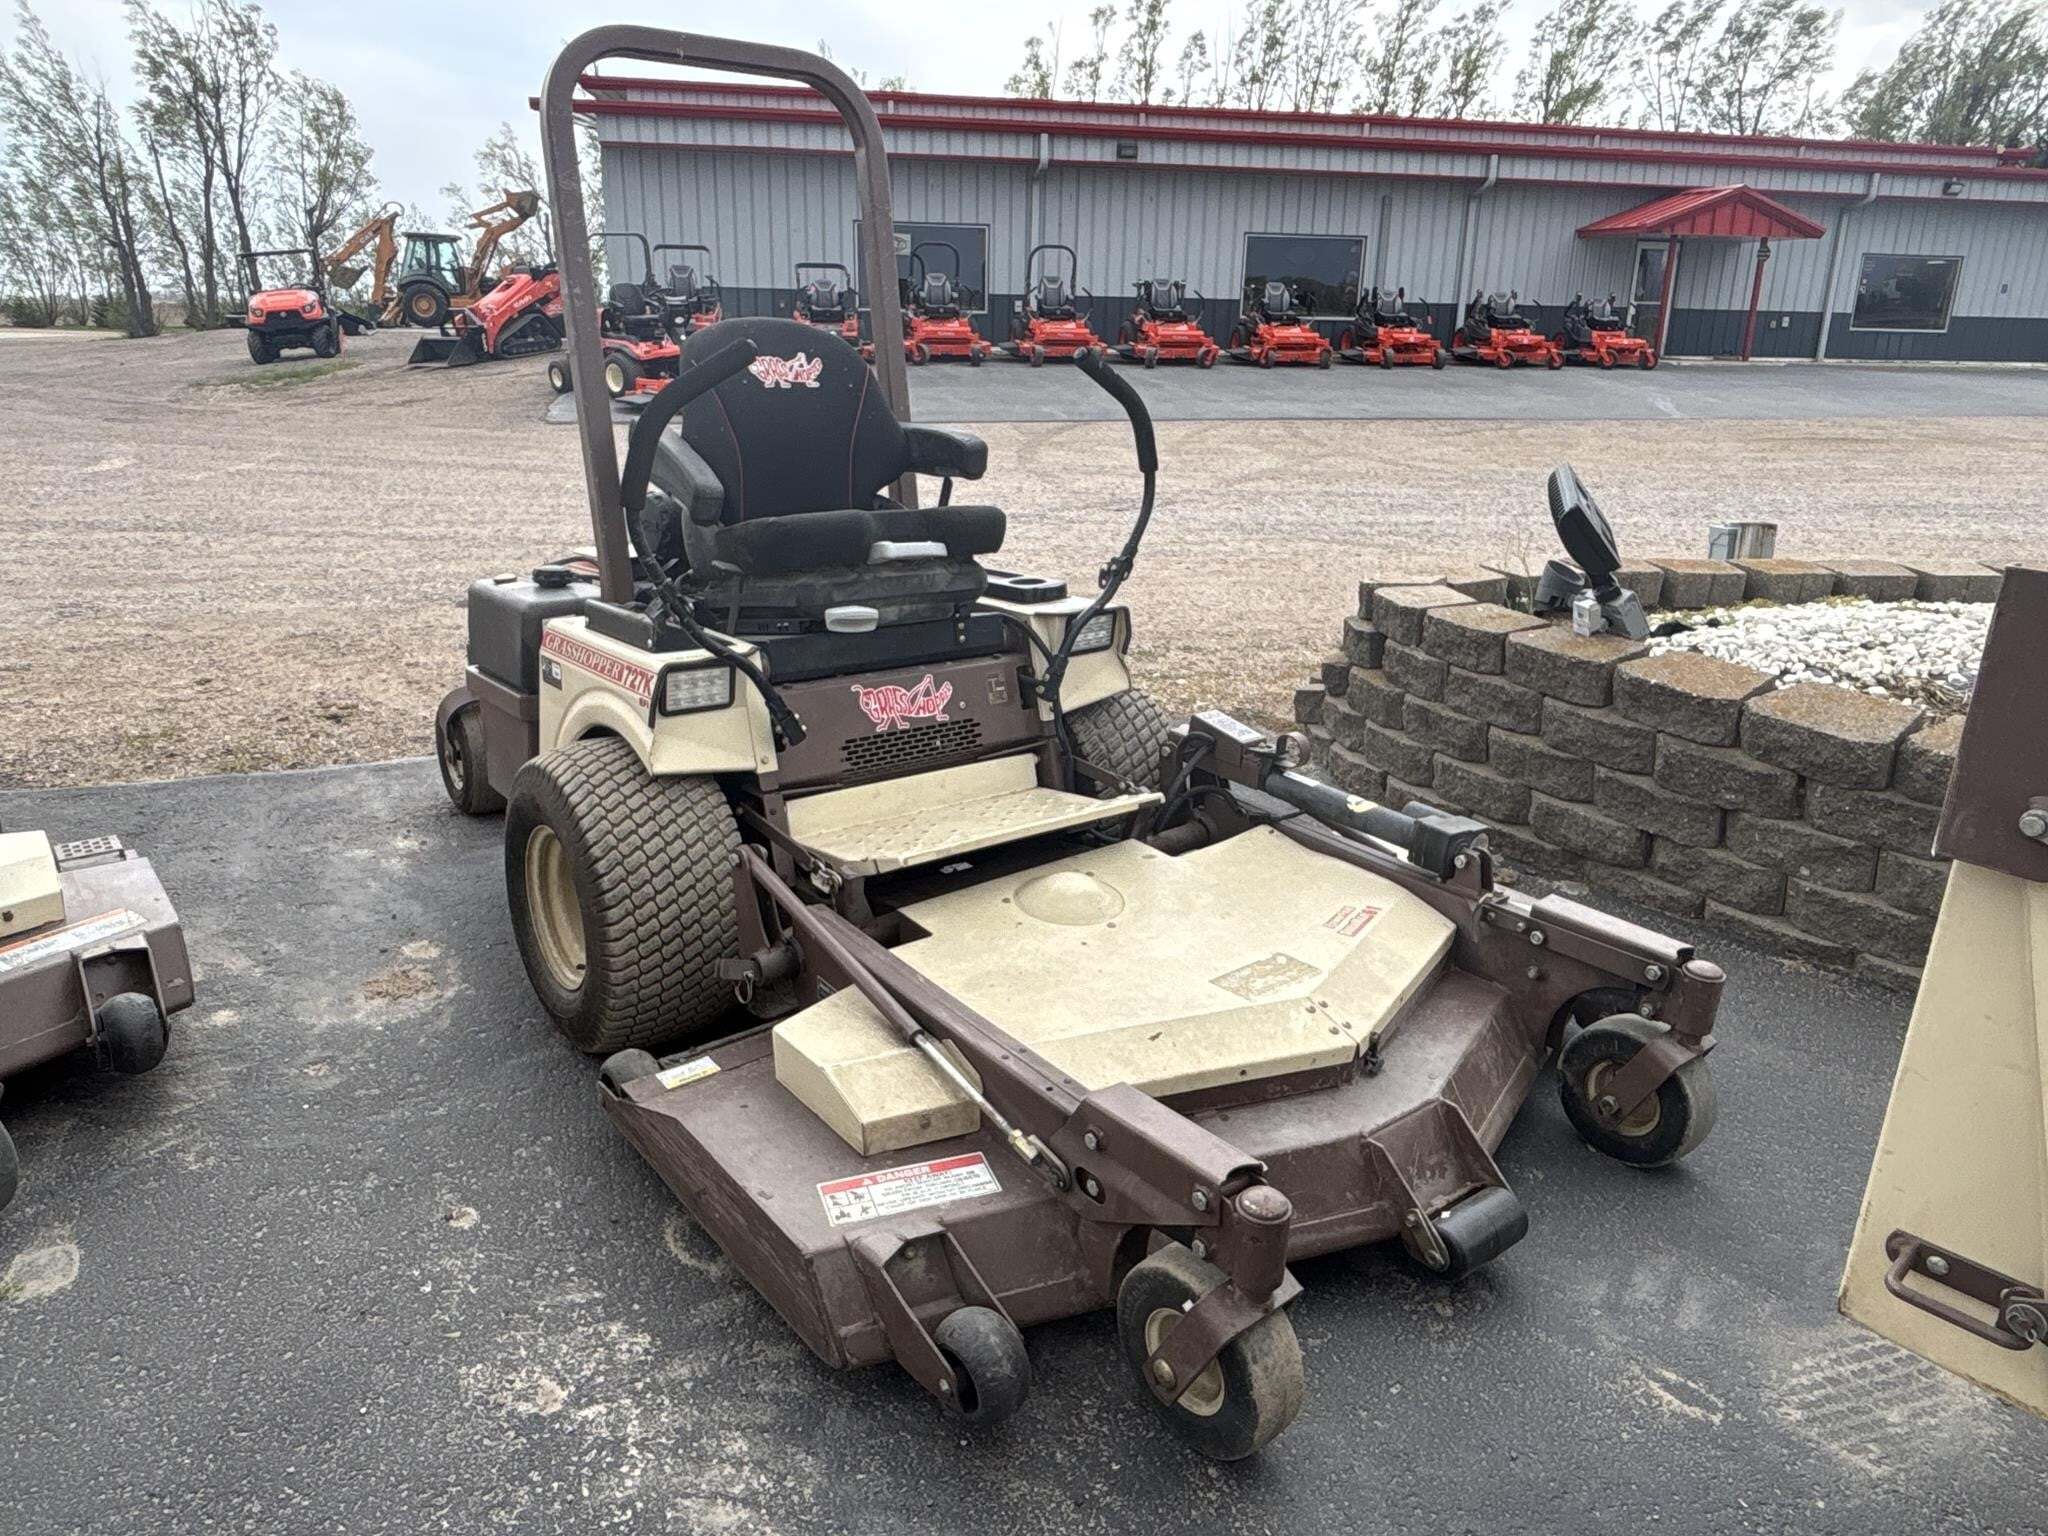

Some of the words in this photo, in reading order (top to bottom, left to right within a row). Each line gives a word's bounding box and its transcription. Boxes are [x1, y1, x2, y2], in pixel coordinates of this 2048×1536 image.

[546, 633, 621, 680] GRASSHOPPER
[624, 664, 655, 697] 727K
[878, 1165, 930, 1184] DANGER
